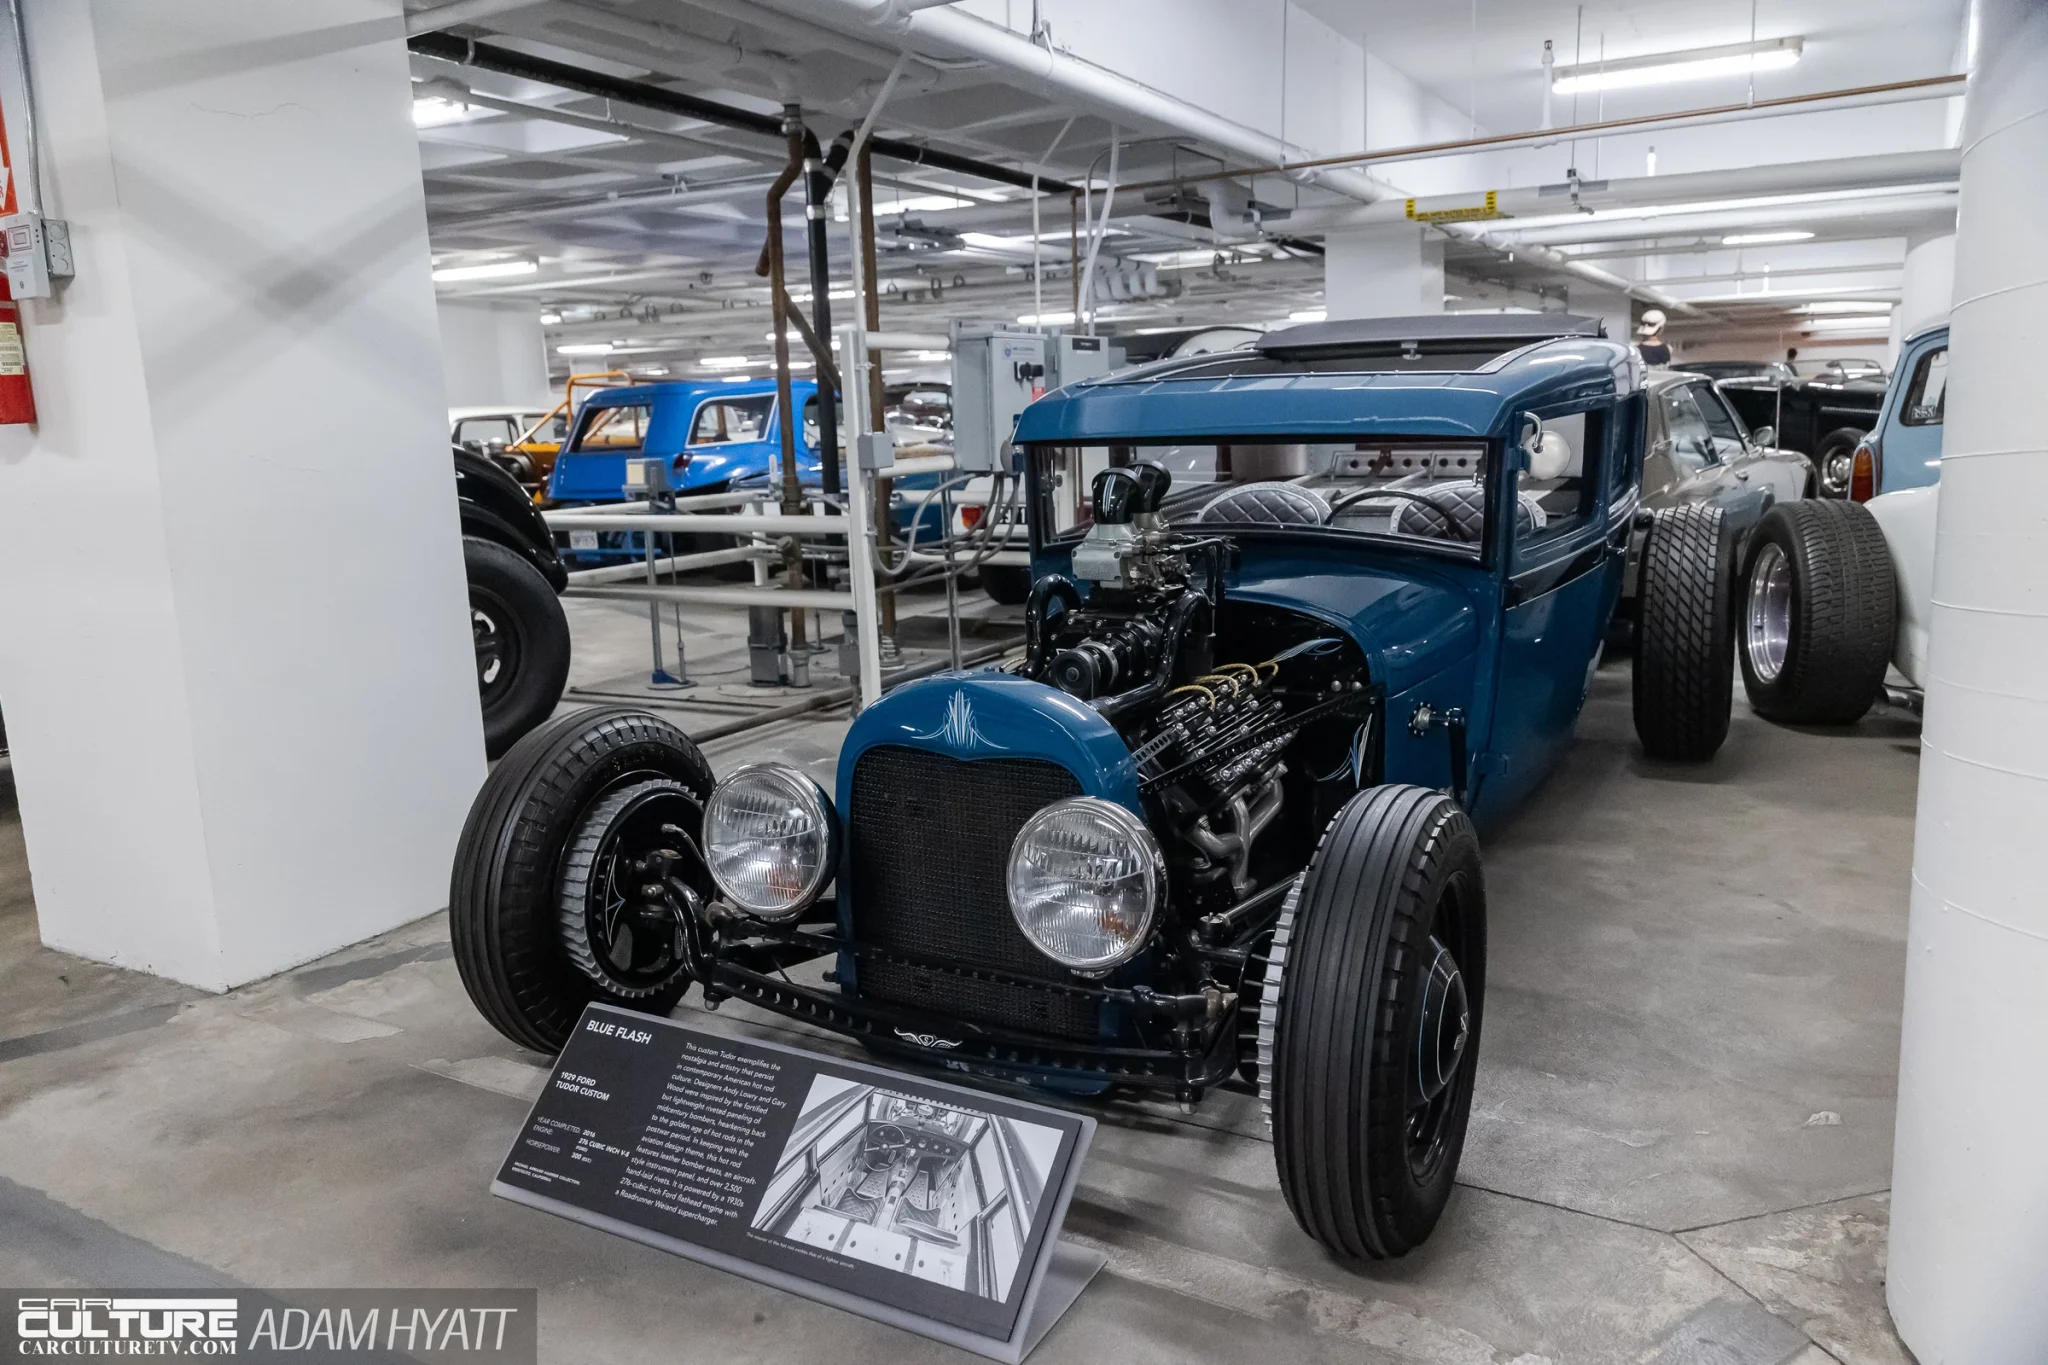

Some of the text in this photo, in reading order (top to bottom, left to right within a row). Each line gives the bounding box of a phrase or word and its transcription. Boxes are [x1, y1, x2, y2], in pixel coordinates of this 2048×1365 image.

[587, 1021, 652, 1044] BLUE FLASH
[681, 1055, 707, 1064] nostalgia
[720, 1064, 741, 1074] artistry
[742, 1068, 753, 1076] that
[754, 1072, 774, 1080] persist
[686, 1043, 697, 1051] This
[698, 1047, 718, 1055] custom
[720, 1051, 736, 1060] Tudor
[737, 1057, 769, 1068] exemplifies
[556, 1081, 609, 1100] TUDOR CUSTOM
[561, 1072, 596, 1086] 1929 FORD
[672, 1074, 691, 1083] culture.
[694, 1078, 722, 1090] Designers
[723, 1086, 739, 1096] Andy
[740, 1090, 758, 1101] Lowry
[772, 1098, 787, 1108] Gary
[683, 1066, 722, 1080] contemporary
[723, 1075, 751, 1086] American
[752, 1081, 762, 1089] hot
[662, 1093, 672, 1101] but
[673, 1096, 704, 1110] lightweight
[706, 1106, 727, 1115] riveted
[726, 1112, 752, 1124] paneling
[667, 1083, 685, 1092] Wood
[700, 1092, 724, 1102] inspired
[724, 1097, 732, 1106] by
[744, 1103, 768, 1114] fortified
[657, 1105, 766, 1137] midcentury bombers, hearkening back
[669, 1120, 690, 1129] golden
[711, 1130, 721, 1138] hot
[744, 1139, 754, 1147] the
[571, 1152, 582, 1160] 300
[589, 1141, 606, 1150] CUBIC
[606, 1146, 620, 1154] INCH
[641, 1136, 663, 1146] aviation
[665, 1142, 684, 1152] design
[685, 1148, 704, 1159] theme,
[707, 1153, 717, 1161] this
[718, 1156, 729, 1164] hot
[646, 1126, 670, 1135] postwar
[670, 1133, 691, 1141] period.
[700, 1139, 723, 1152] keeping
[739, 1150, 748, 1158] the
[631, 1157, 645, 1165] style
[646, 1161, 677, 1174] instrument
[677, 1171, 695, 1181] panel,
[724, 1183, 742, 1193] 2,500
[636, 1145, 659, 1157] features
[660, 1152, 680, 1162] leather
[681, 1158, 705, 1169] bomber
[706, 1167, 722, 1176] seats,
[733, 1174, 756, 1184] aircraft-
[620, 1177, 737, 1218] 276-cubic inch Ford flathead engine with
[626, 1166, 653, 1179] hand-laid
[654, 1177, 670, 1185] rivets.
[683, 1186, 712, 1197] powered
[712, 1192, 719, 1201] by
[727, 1197, 744, 1207] 1930s
[620, 1190, 654, 1205] Roadrunner
[655, 1200, 678, 1212] Weiand
[678, 1209, 717, 1225] supercharger.
